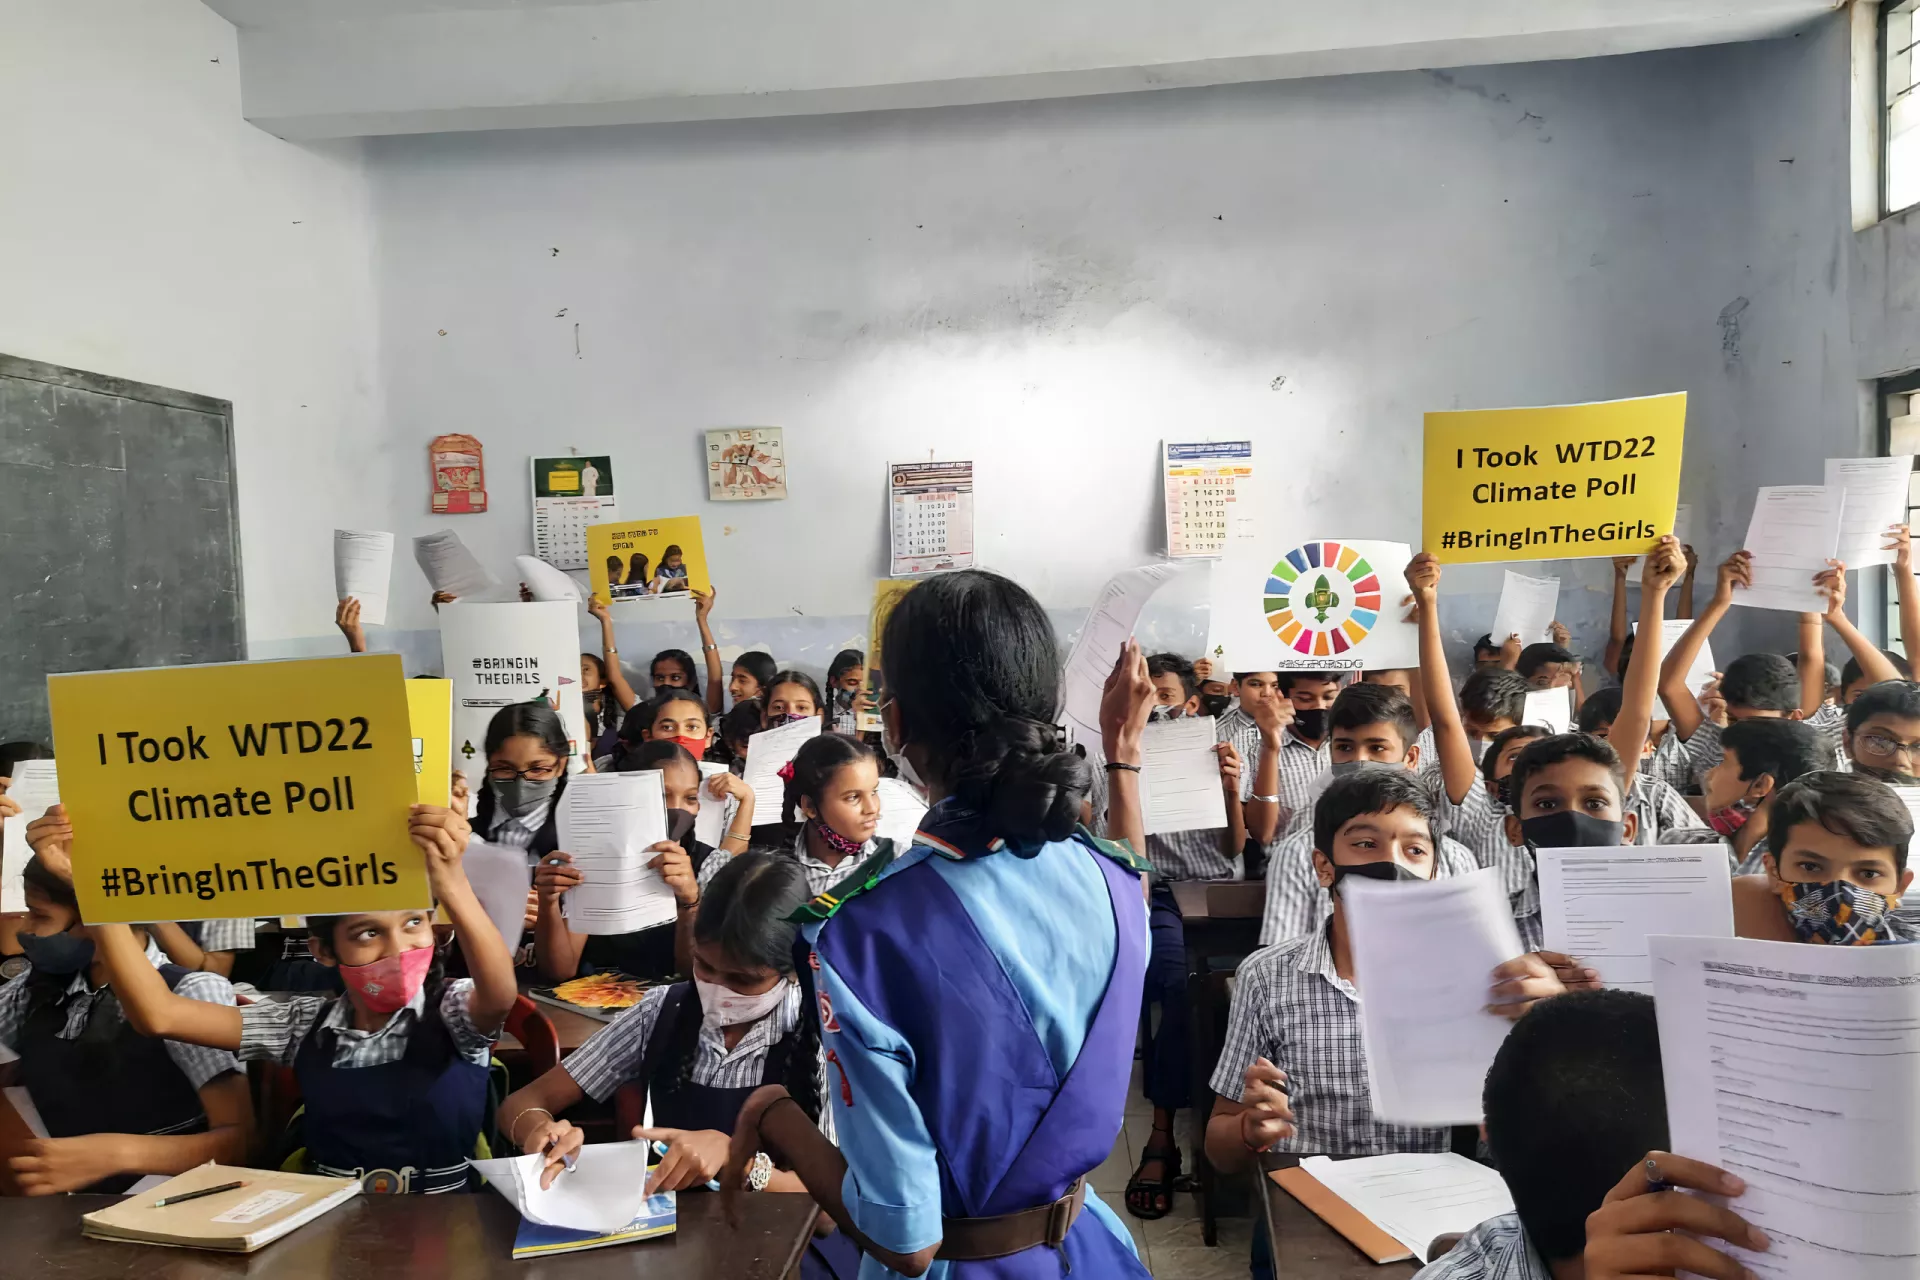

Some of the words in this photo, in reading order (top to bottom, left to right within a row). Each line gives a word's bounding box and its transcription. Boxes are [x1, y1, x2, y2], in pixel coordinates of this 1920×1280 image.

[1457, 448, 1463, 469] I
[1472, 444, 1538, 468] Took
[1555, 435, 1656, 464] WTD22
[1472, 482, 1577, 504] Climate
[1587, 474, 1636, 498] Poll
[1441, 519, 1656, 551] #BringInTheGirls
[475, 672, 540, 685] THEGIRLS
[98, 733, 107, 765] I
[116, 725, 210, 764] Took
[227, 716, 373, 758] WTD22
[128, 786, 272, 822] Climate
[284, 775, 355, 814] Poll
[100, 852, 399, 900] #BringInTheGirls
